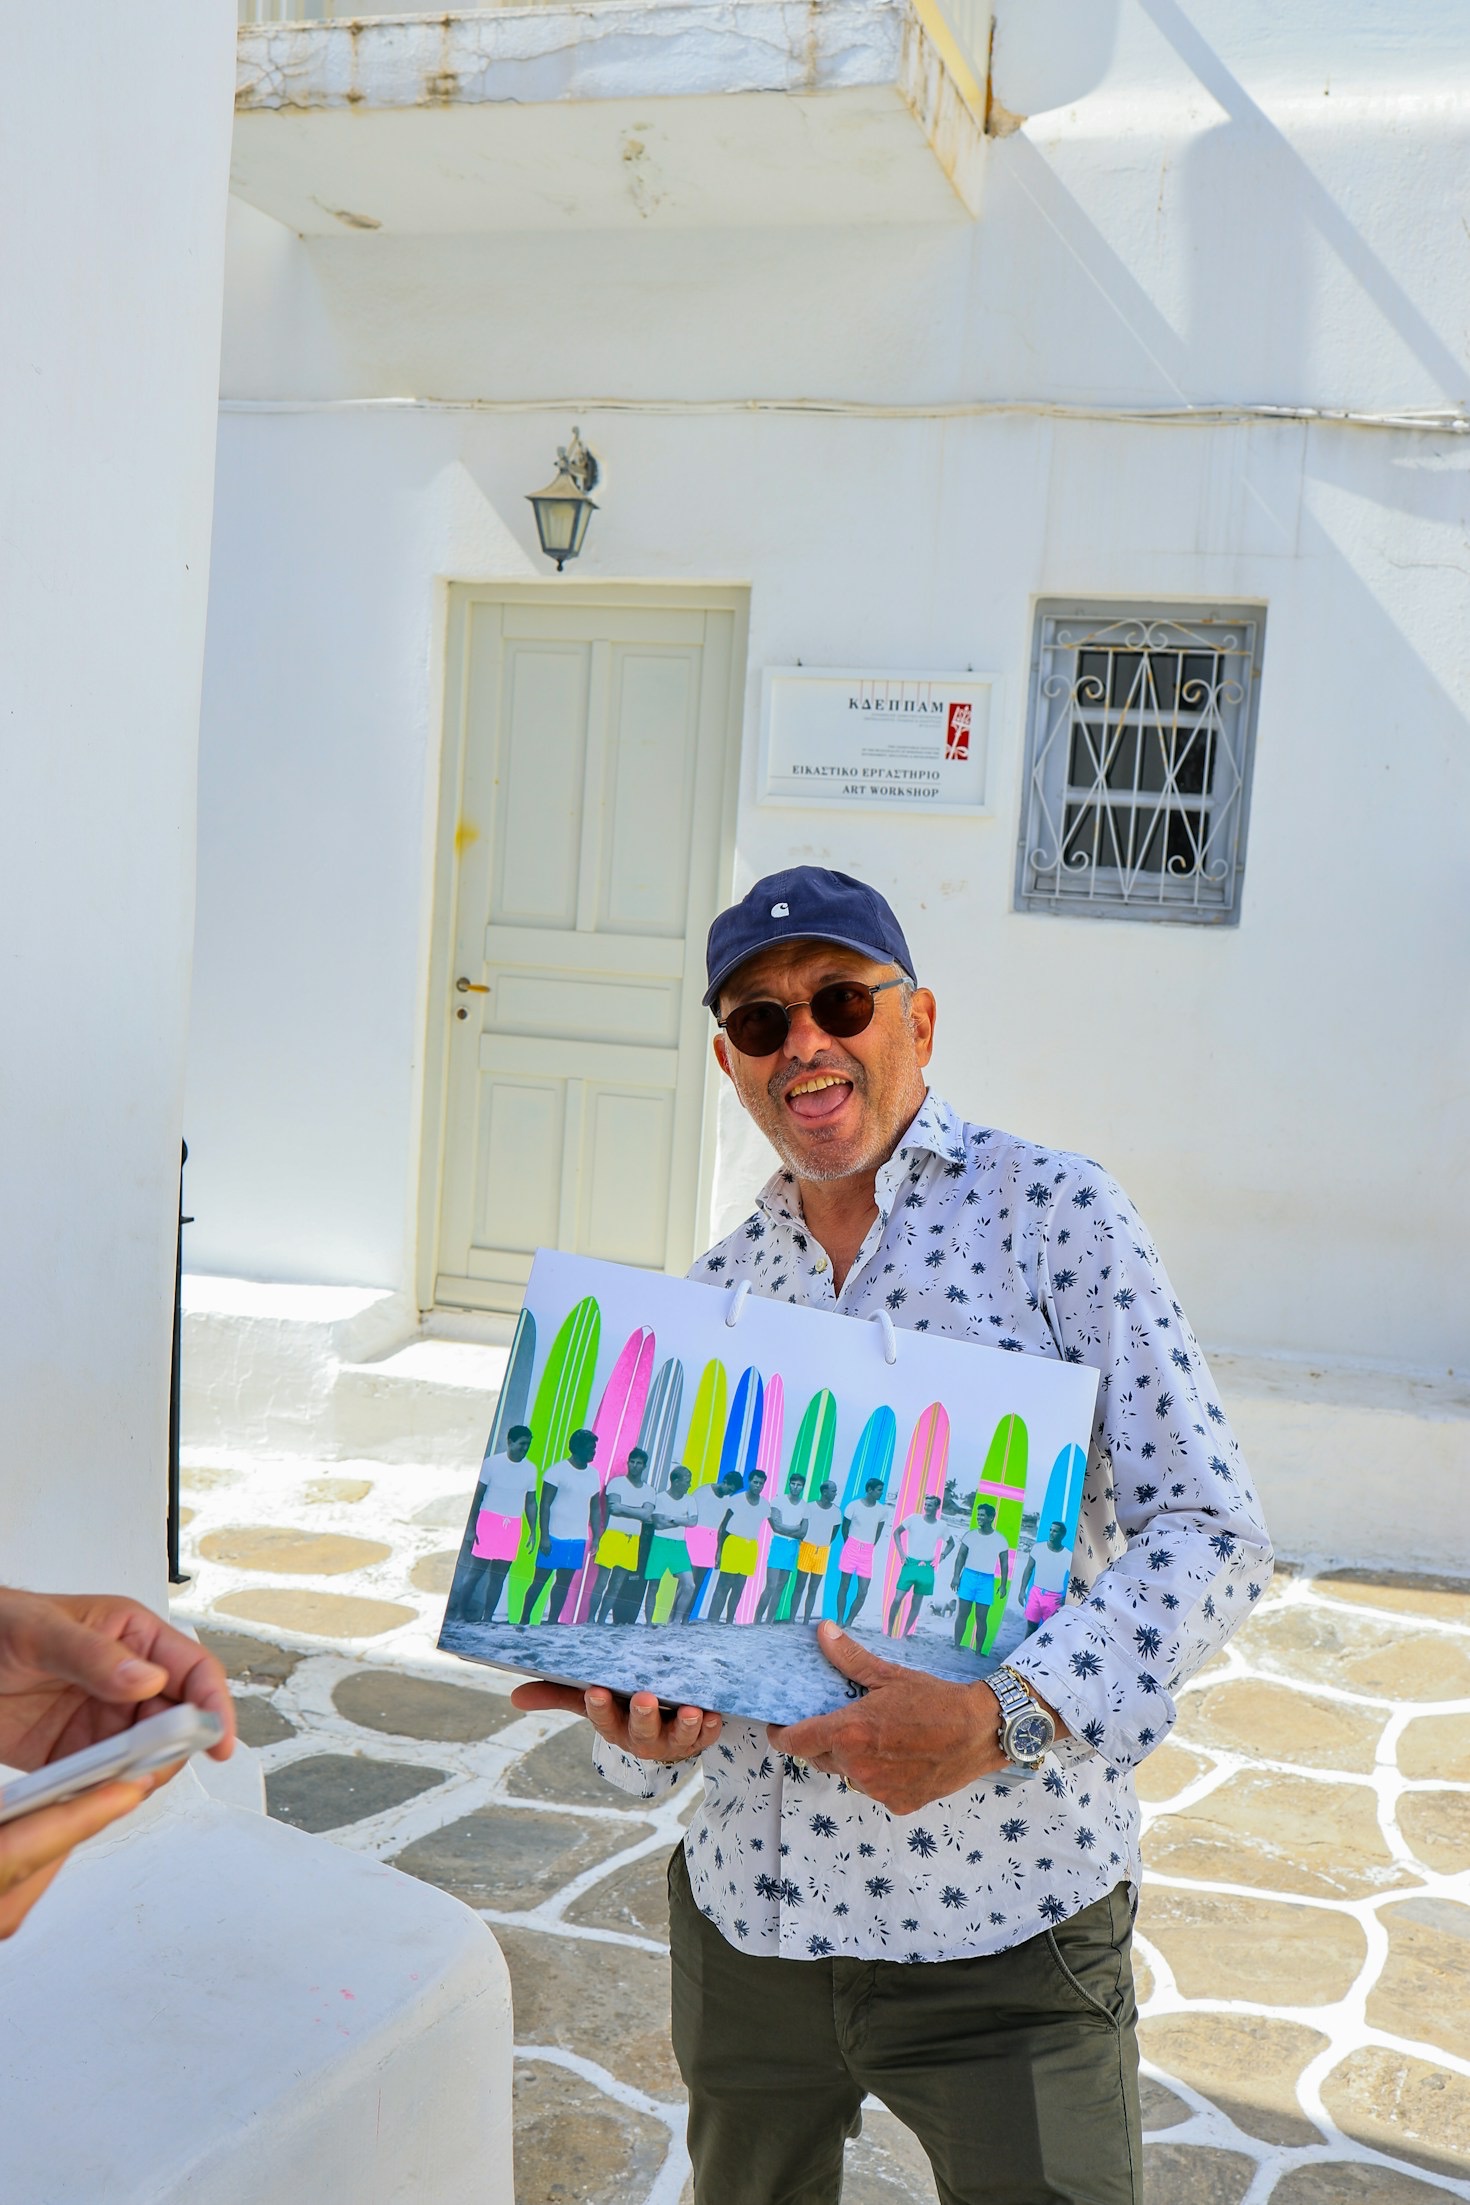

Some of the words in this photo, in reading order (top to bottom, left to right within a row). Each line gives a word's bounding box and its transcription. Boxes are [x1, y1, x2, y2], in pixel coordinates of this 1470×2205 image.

[849, 698, 944, 713] ΚΔΕΠΠΑΜ
[792, 765, 858, 777] ΕΙΚΑΣΤΙΚΟ
[862, 768, 940, 780] ΕΡΓΑΣΤΗΡΙΟ
[842, 785, 867, 795] ART
[871, 786, 940, 798] WORKSHOP
